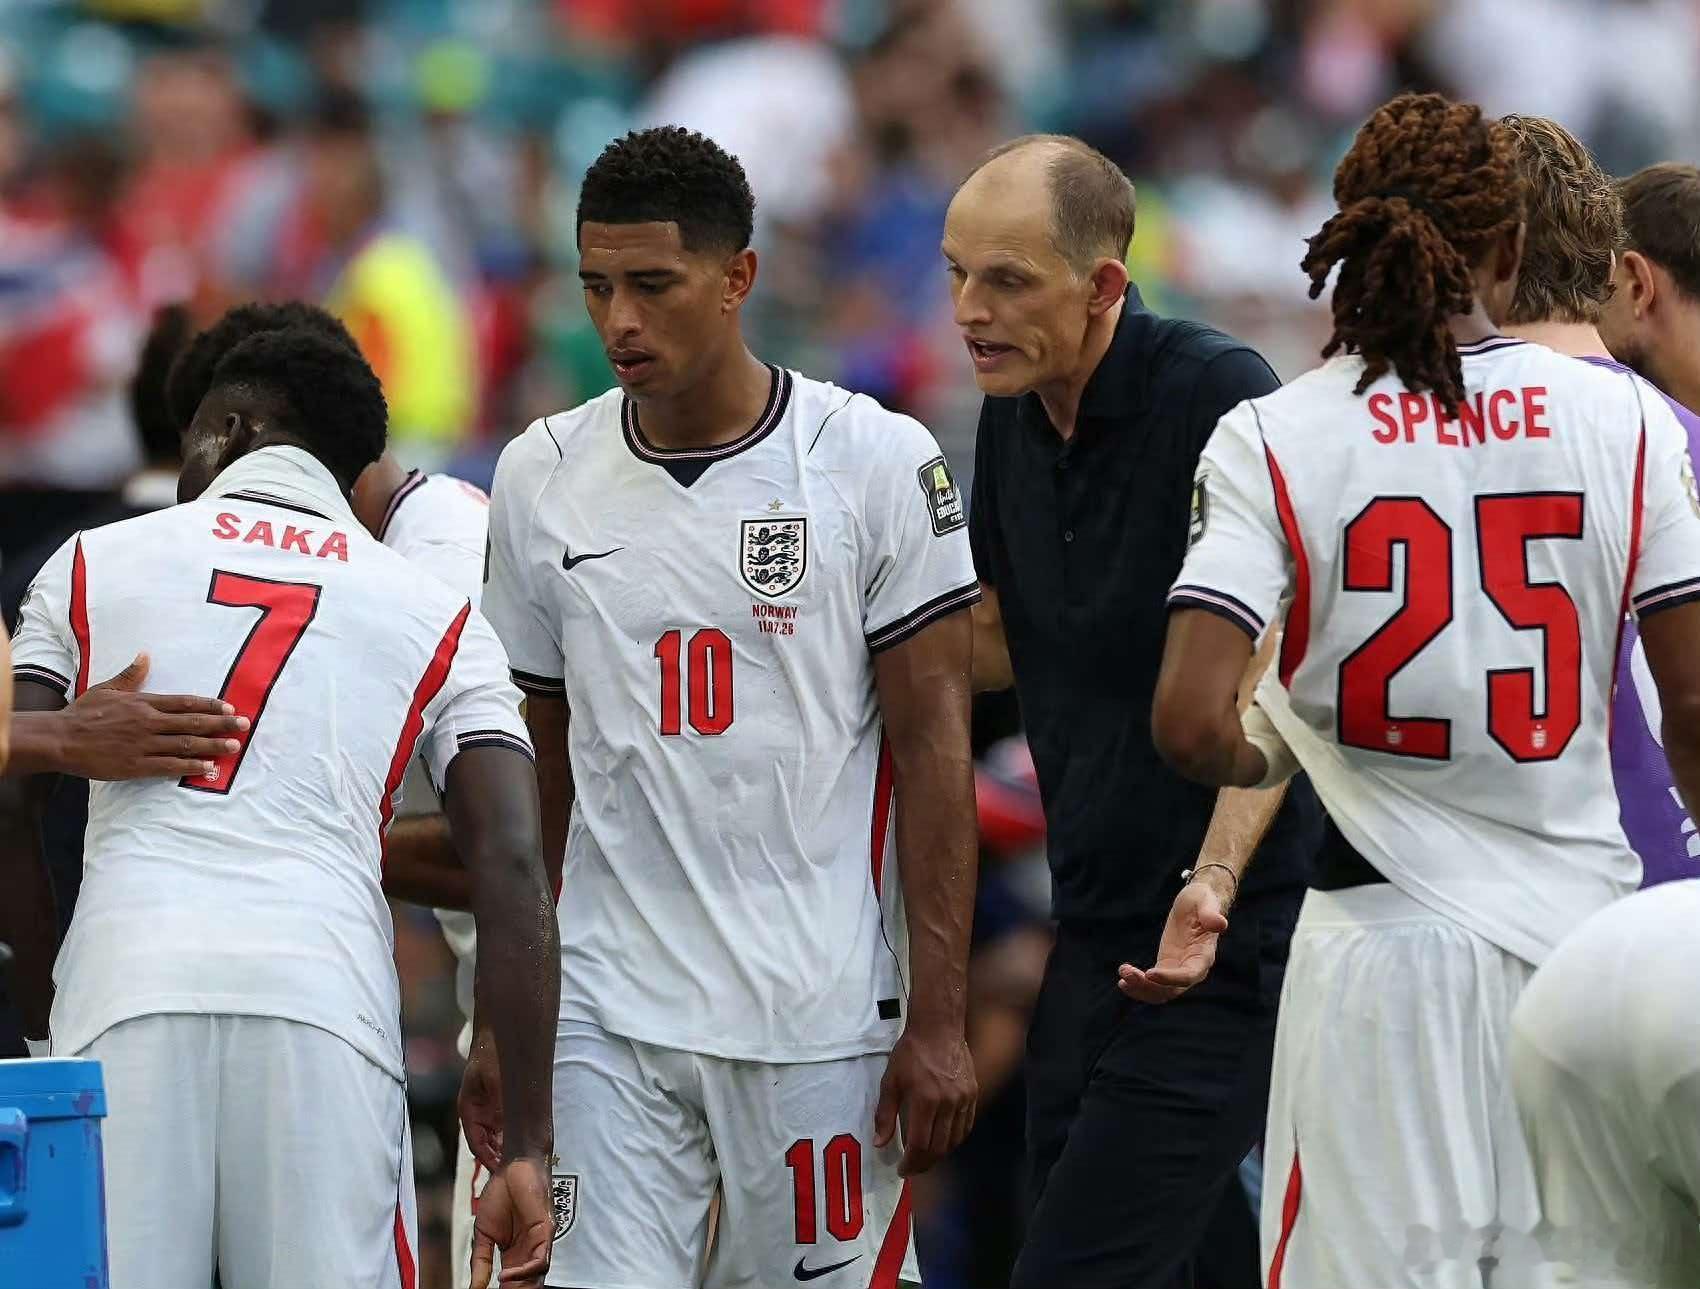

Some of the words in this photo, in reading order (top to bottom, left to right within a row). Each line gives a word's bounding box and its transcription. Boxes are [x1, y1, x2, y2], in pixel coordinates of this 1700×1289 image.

[1368, 387, 1550, 447] SPENCE
[212, 512, 348, 562] SAKA
[752, 604, 798, 619] NORWAY
[1337, 491, 1585, 763] 25
[179, 568, 323, 795] 7
[654, 628, 734, 736] 10
[785, 1133, 864, 1245] 10
